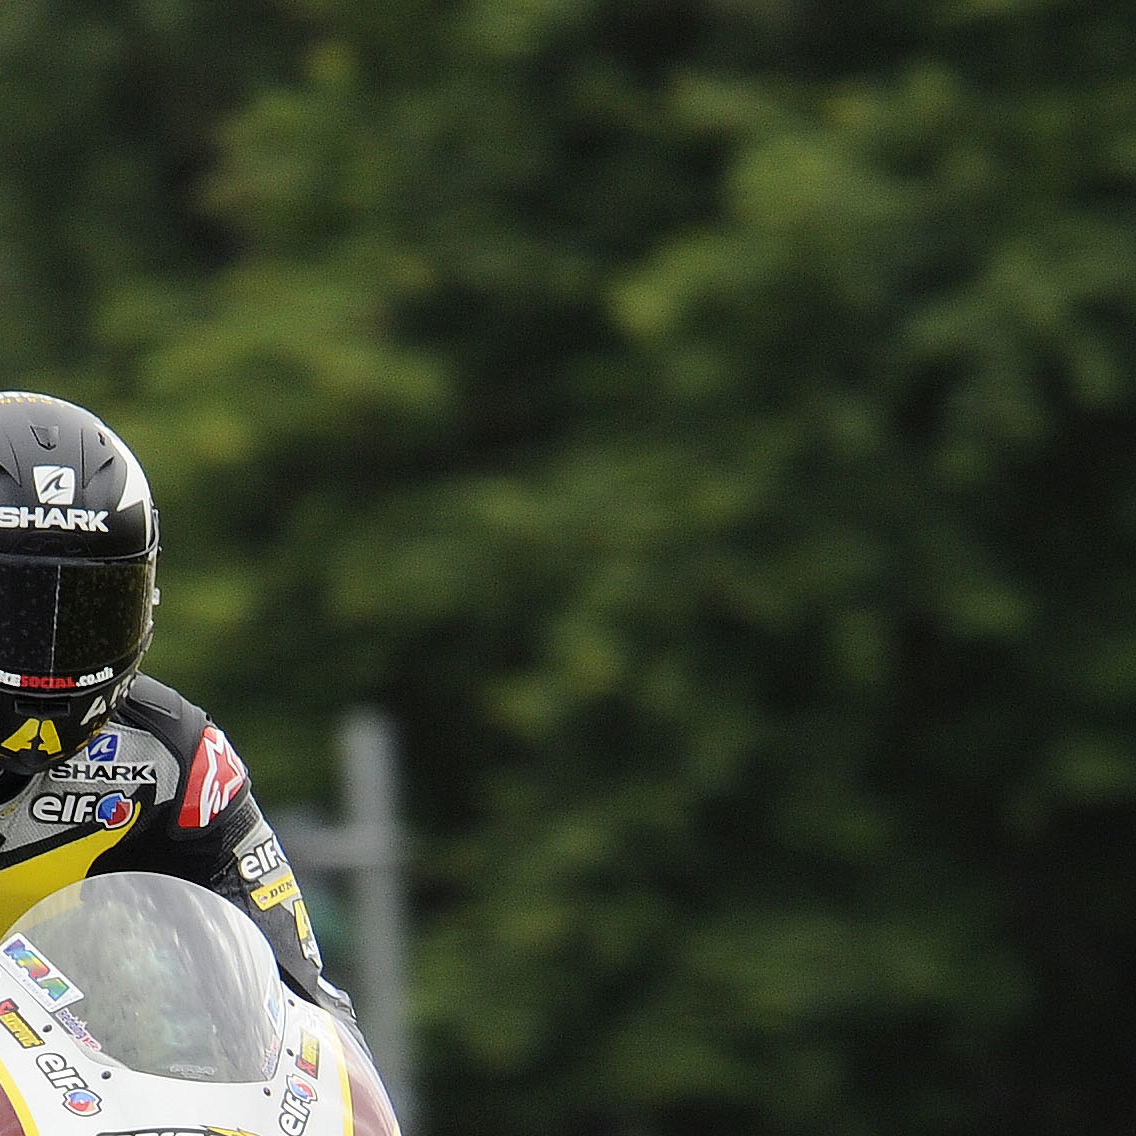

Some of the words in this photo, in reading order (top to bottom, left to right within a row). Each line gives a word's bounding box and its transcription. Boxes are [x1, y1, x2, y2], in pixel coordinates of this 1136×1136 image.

[51, 763, 150, 781] SHARK
[33, 794, 98, 823] elf
[239, 838, 280, 880] elf
[269, 880, 294, 898] DUN
[36, 1053, 88, 1089] elf
